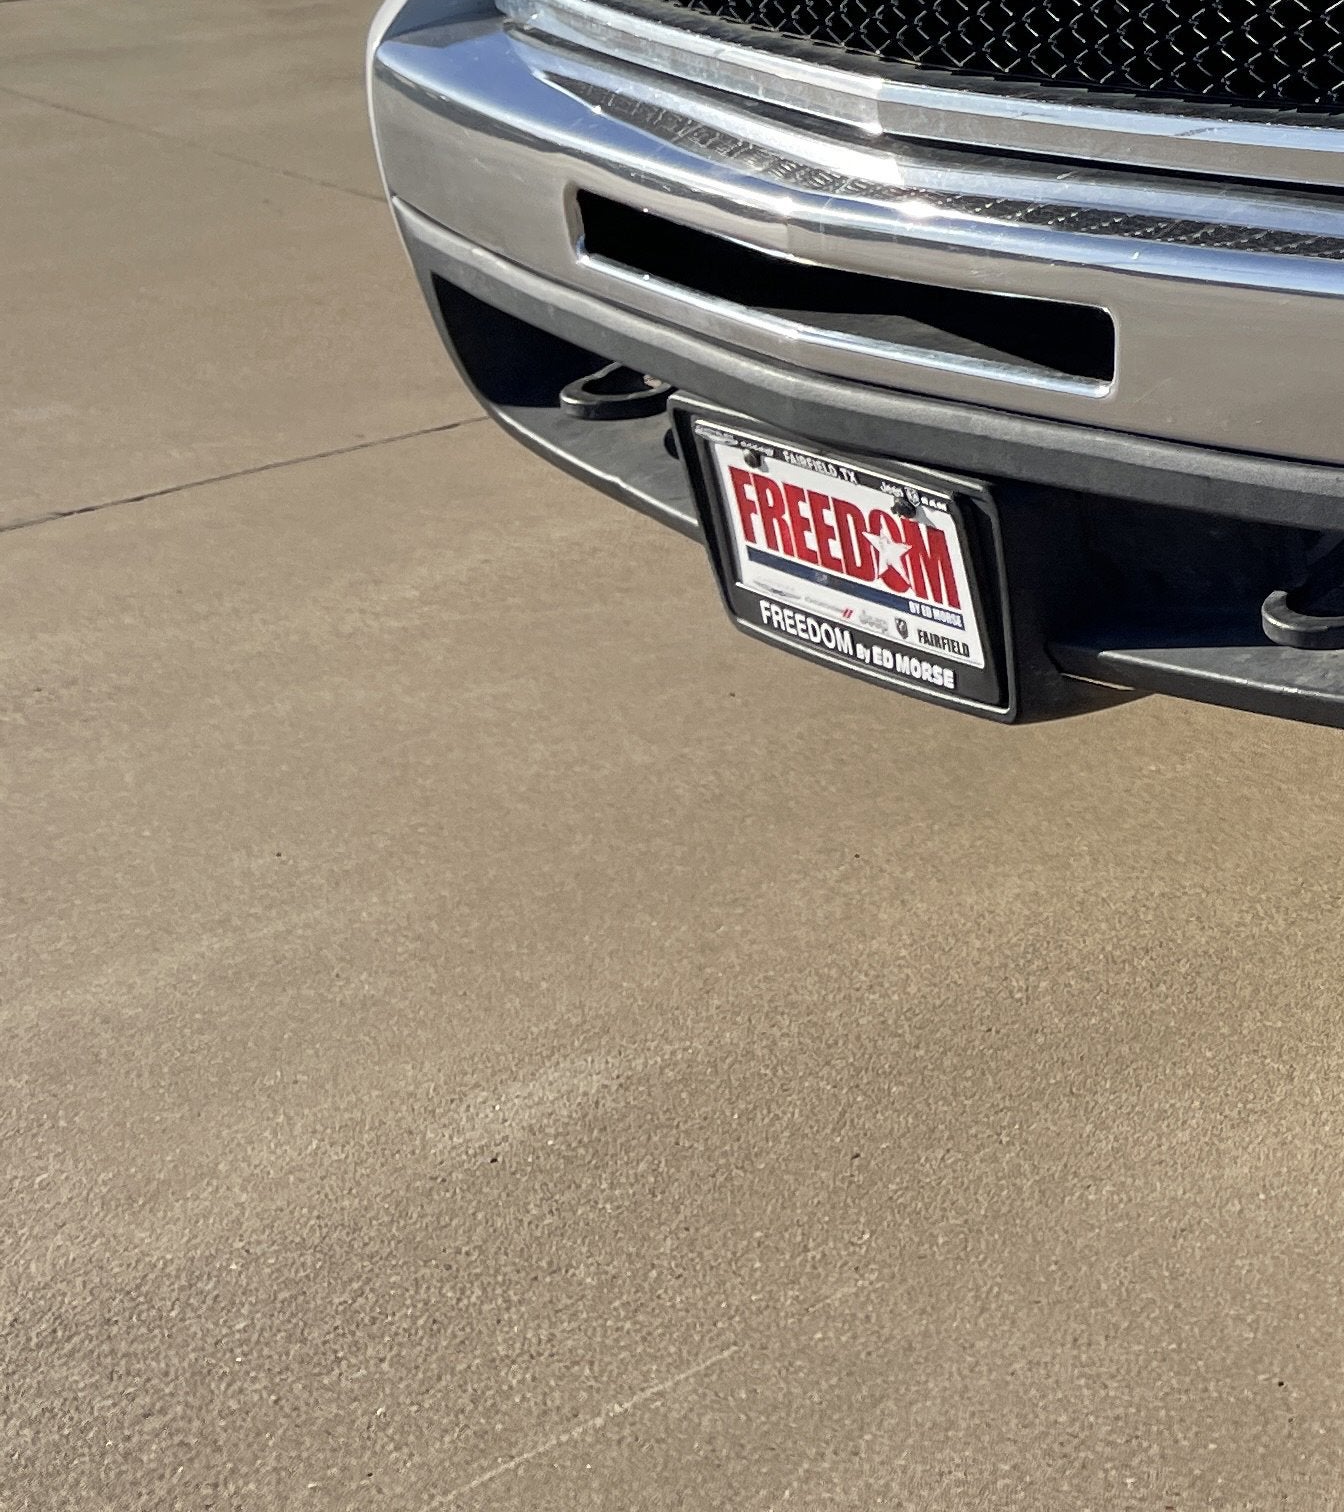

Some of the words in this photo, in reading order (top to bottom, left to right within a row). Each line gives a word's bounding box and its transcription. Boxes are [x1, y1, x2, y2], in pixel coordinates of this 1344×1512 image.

[839, 467, 859, 486] TX
[728, 465, 962, 611] FREEDOM
[908, 600, 921, 616] BY
[920, 604, 933, 619] ED
[759, 599, 854, 657] FREEDOM
[872, 644, 895, 670] ED
[894, 652, 955, 689] MORSE
[917, 628, 970, 658] FAIRFIELD
